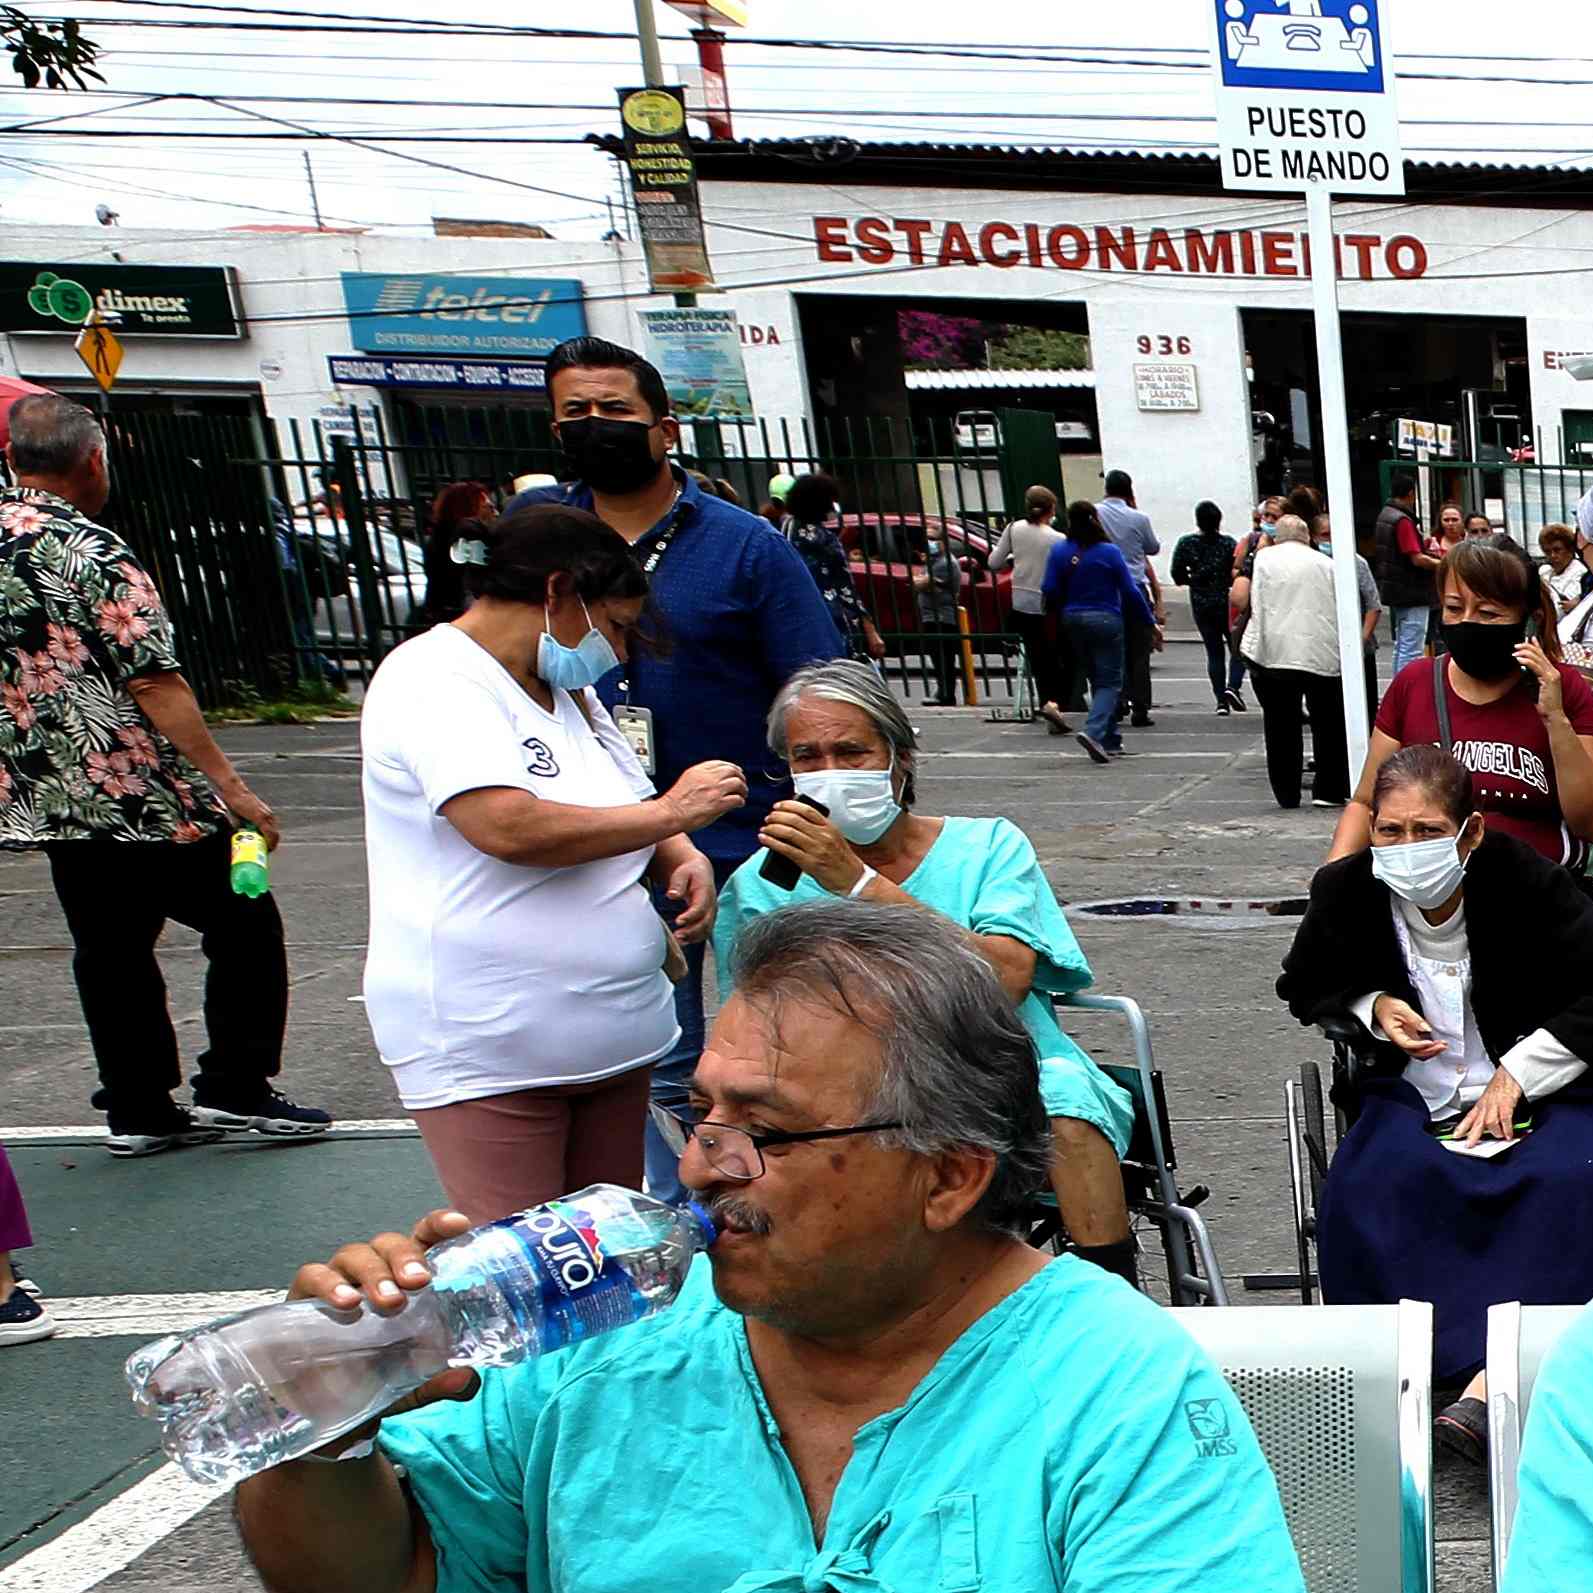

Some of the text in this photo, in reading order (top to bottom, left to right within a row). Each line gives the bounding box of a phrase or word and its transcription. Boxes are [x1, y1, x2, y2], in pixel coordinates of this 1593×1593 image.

[1247, 106, 1366, 139] PUESTO
[1232, 148, 1389, 181] DE MANDO
[97, 288, 188, 313] dimex
[420, 286, 553, 324] telcel
[374, 331, 559, 350] DISTRIBUIDOR AUTORIZADO
[648, 322, 733, 333] HIDROTERAPIA
[1137, 335, 1191, 355] 936
[522, 738, 560, 778] 3
[1451, 741, 1549, 794] ANGELES
[514, 1206, 595, 1291] pura
[1194, 1438, 1237, 1457] IMSS
